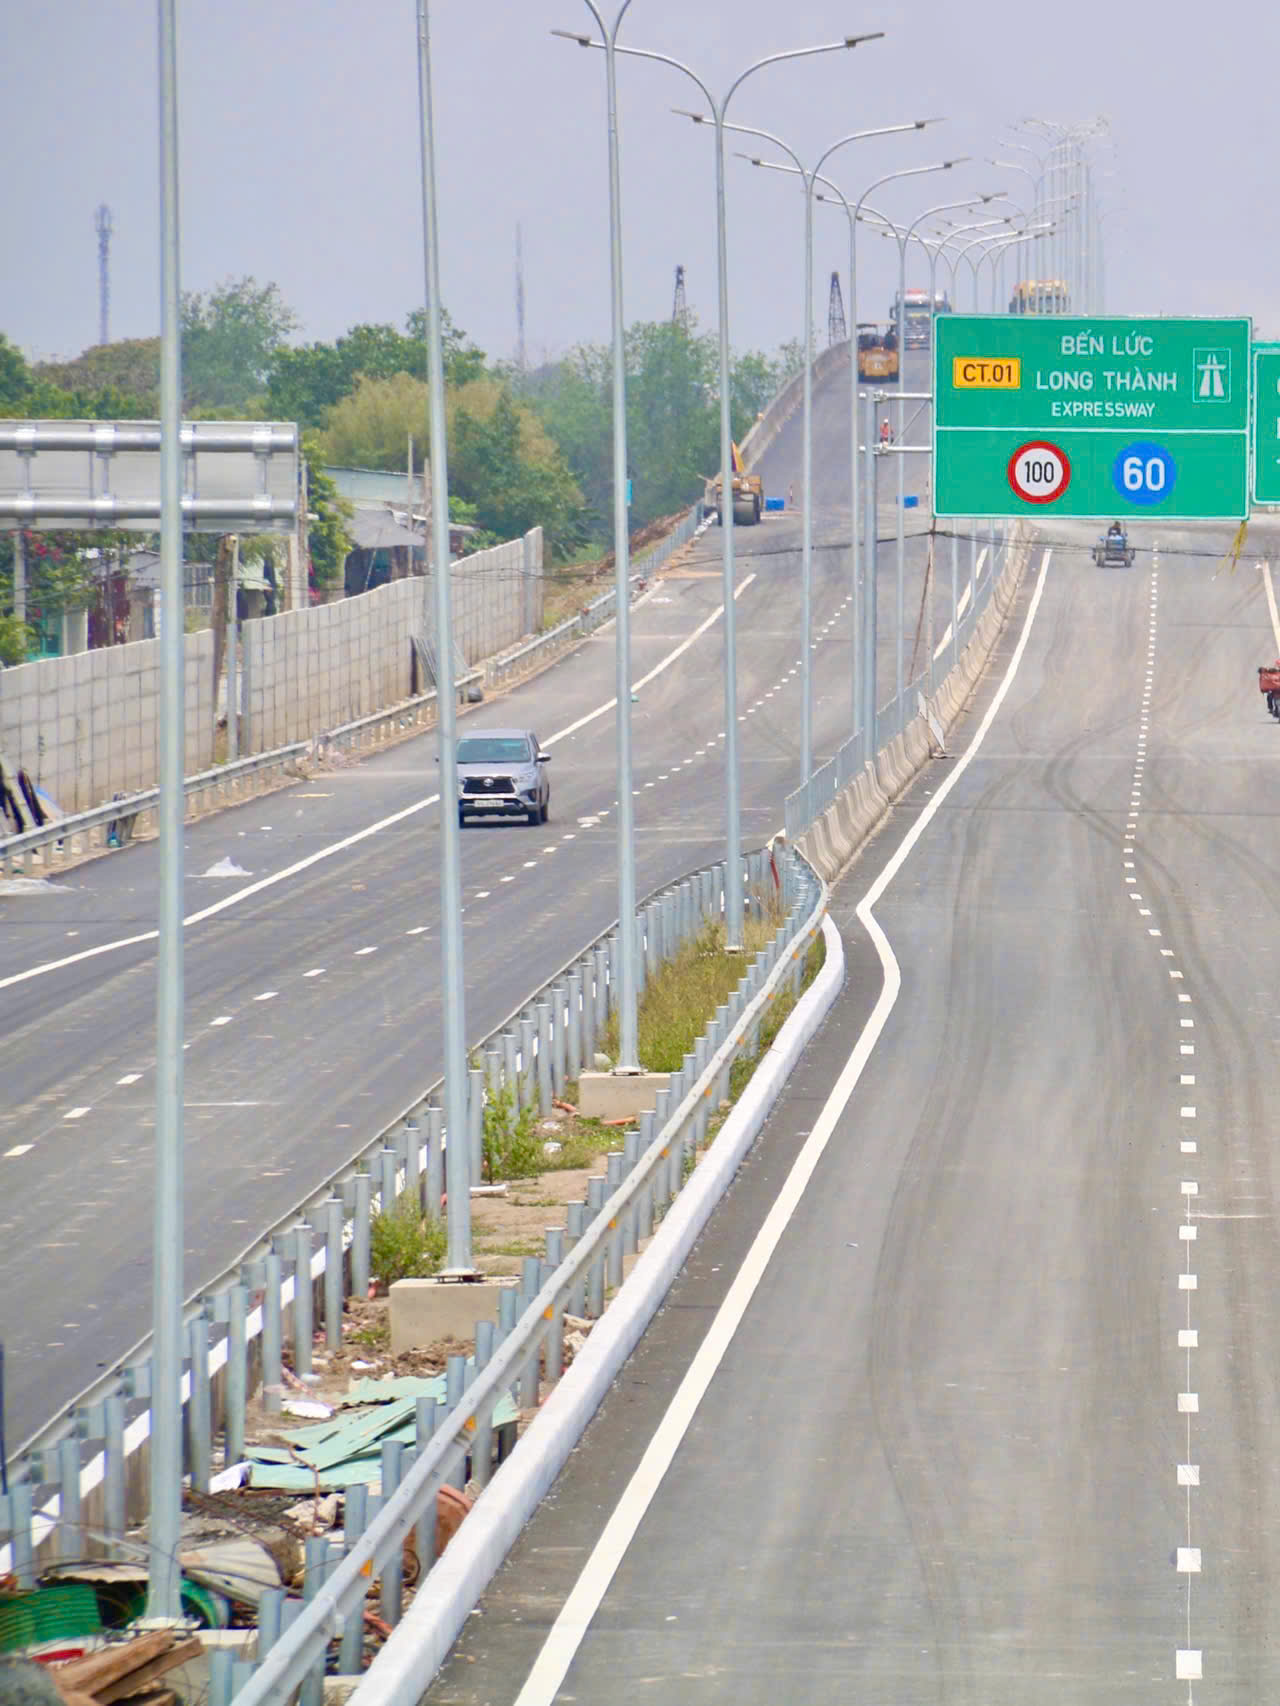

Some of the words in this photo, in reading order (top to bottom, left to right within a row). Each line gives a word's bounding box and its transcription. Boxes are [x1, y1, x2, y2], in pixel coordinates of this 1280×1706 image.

[1061, 329, 1105, 356] BẾN
[962, 363, 1013, 383] CT.01
[1036, 371, 1094, 391] LONG
[1103, 366, 1178, 391] THÀNH
[1051, 402, 1156, 417] EXPRESSWAY
[1024, 461, 1055, 483] 100
[1123, 457, 1165, 491] 60
